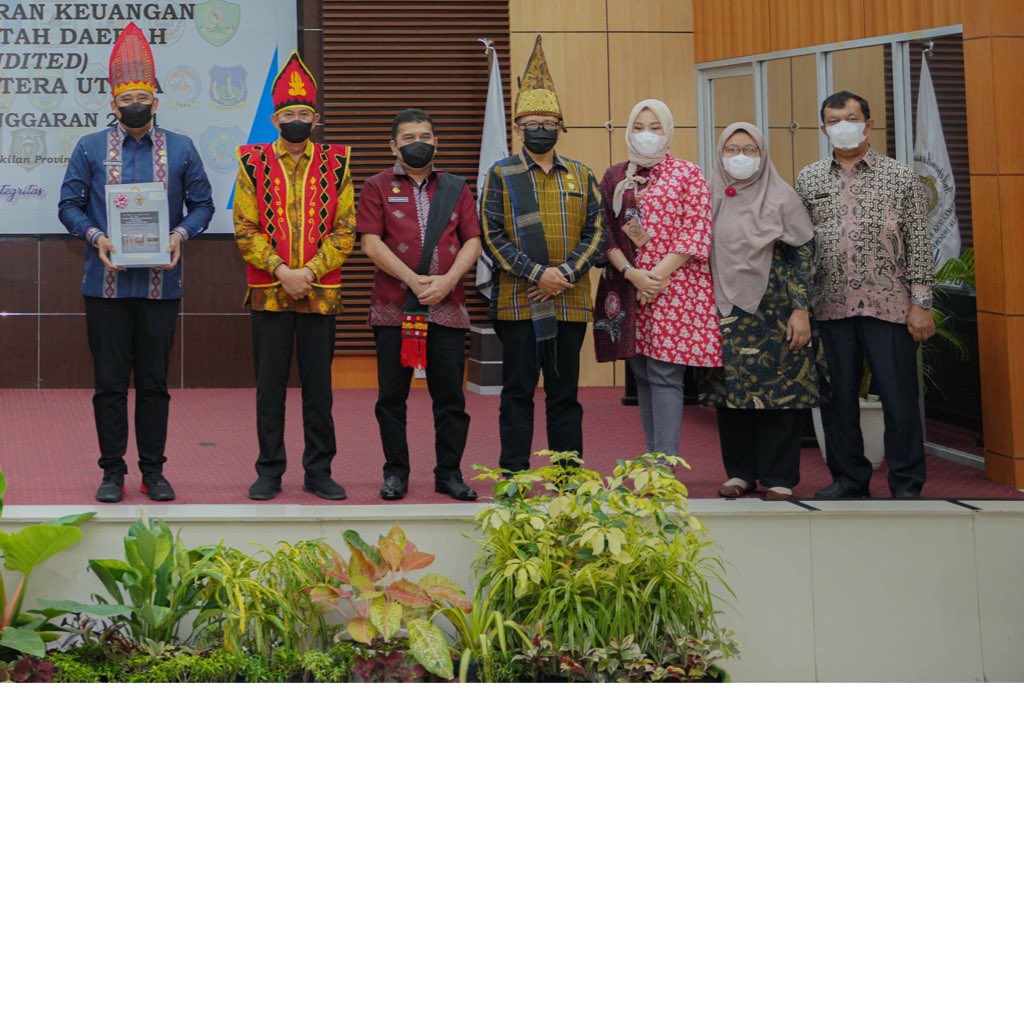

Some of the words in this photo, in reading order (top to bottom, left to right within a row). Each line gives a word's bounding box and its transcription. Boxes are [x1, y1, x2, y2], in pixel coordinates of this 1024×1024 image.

[54, 4, 196, 20] KEUANGAN
[59, 28, 167, 45] DAEH
[76, 77, 164, 94] UTA
[106, 113, 159, 127] 21
[33, 155, 70, 164] Provin
